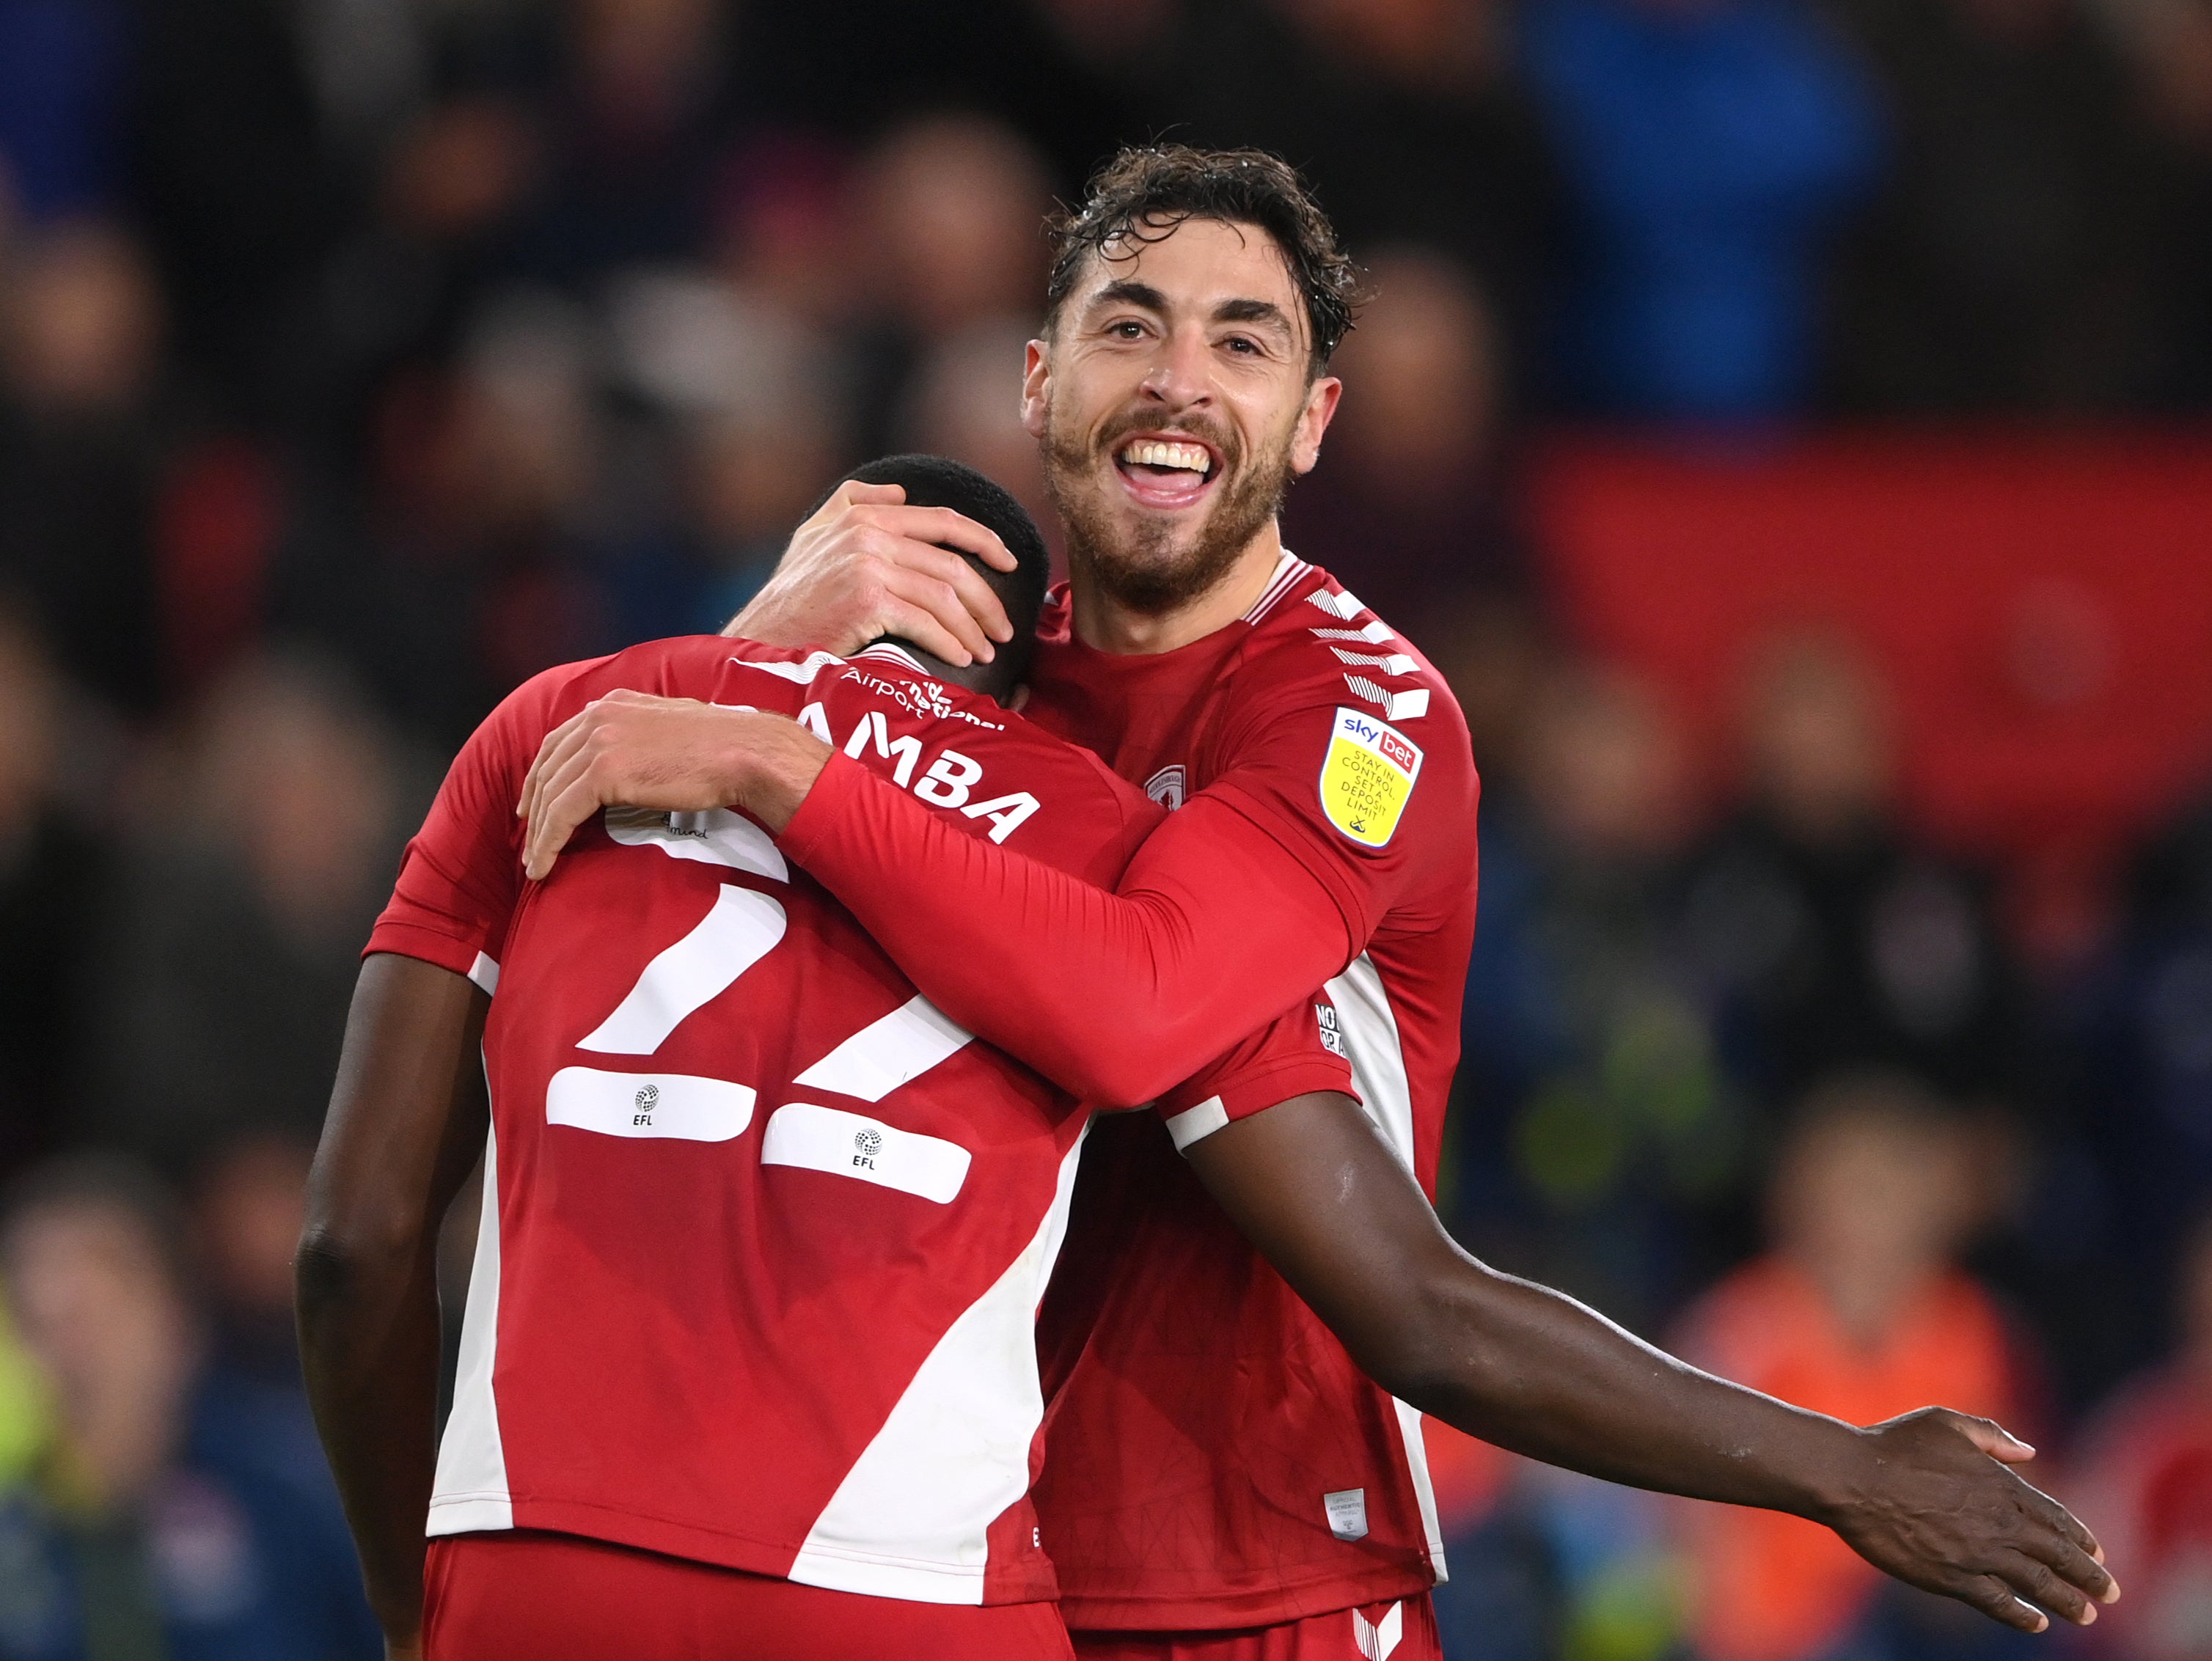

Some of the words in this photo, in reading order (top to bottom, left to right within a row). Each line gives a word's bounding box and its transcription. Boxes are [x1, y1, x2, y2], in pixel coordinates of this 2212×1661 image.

[840, 667, 926, 720] Airport
[1344, 719, 1379, 743] sky
[1382, 734, 1413, 768] bet
[708, 700, 1041, 846] AMBA
[1341, 757, 1395, 800] CONTROL.
[1354, 750, 1382, 771] STAY
[1383, 768, 1394, 782] IN
[1341, 781, 1387, 816] DEPOSIT
[1354, 775, 1375, 793] SET
[1375, 791, 1382, 801] A
[1347, 796, 1378, 821] LIMIT
[669, 826, 708, 840] mind
[1315, 1004, 1336, 1030] NO
[633, 1115, 653, 1126] EFL
[852, 1155, 876, 1170] EFL
